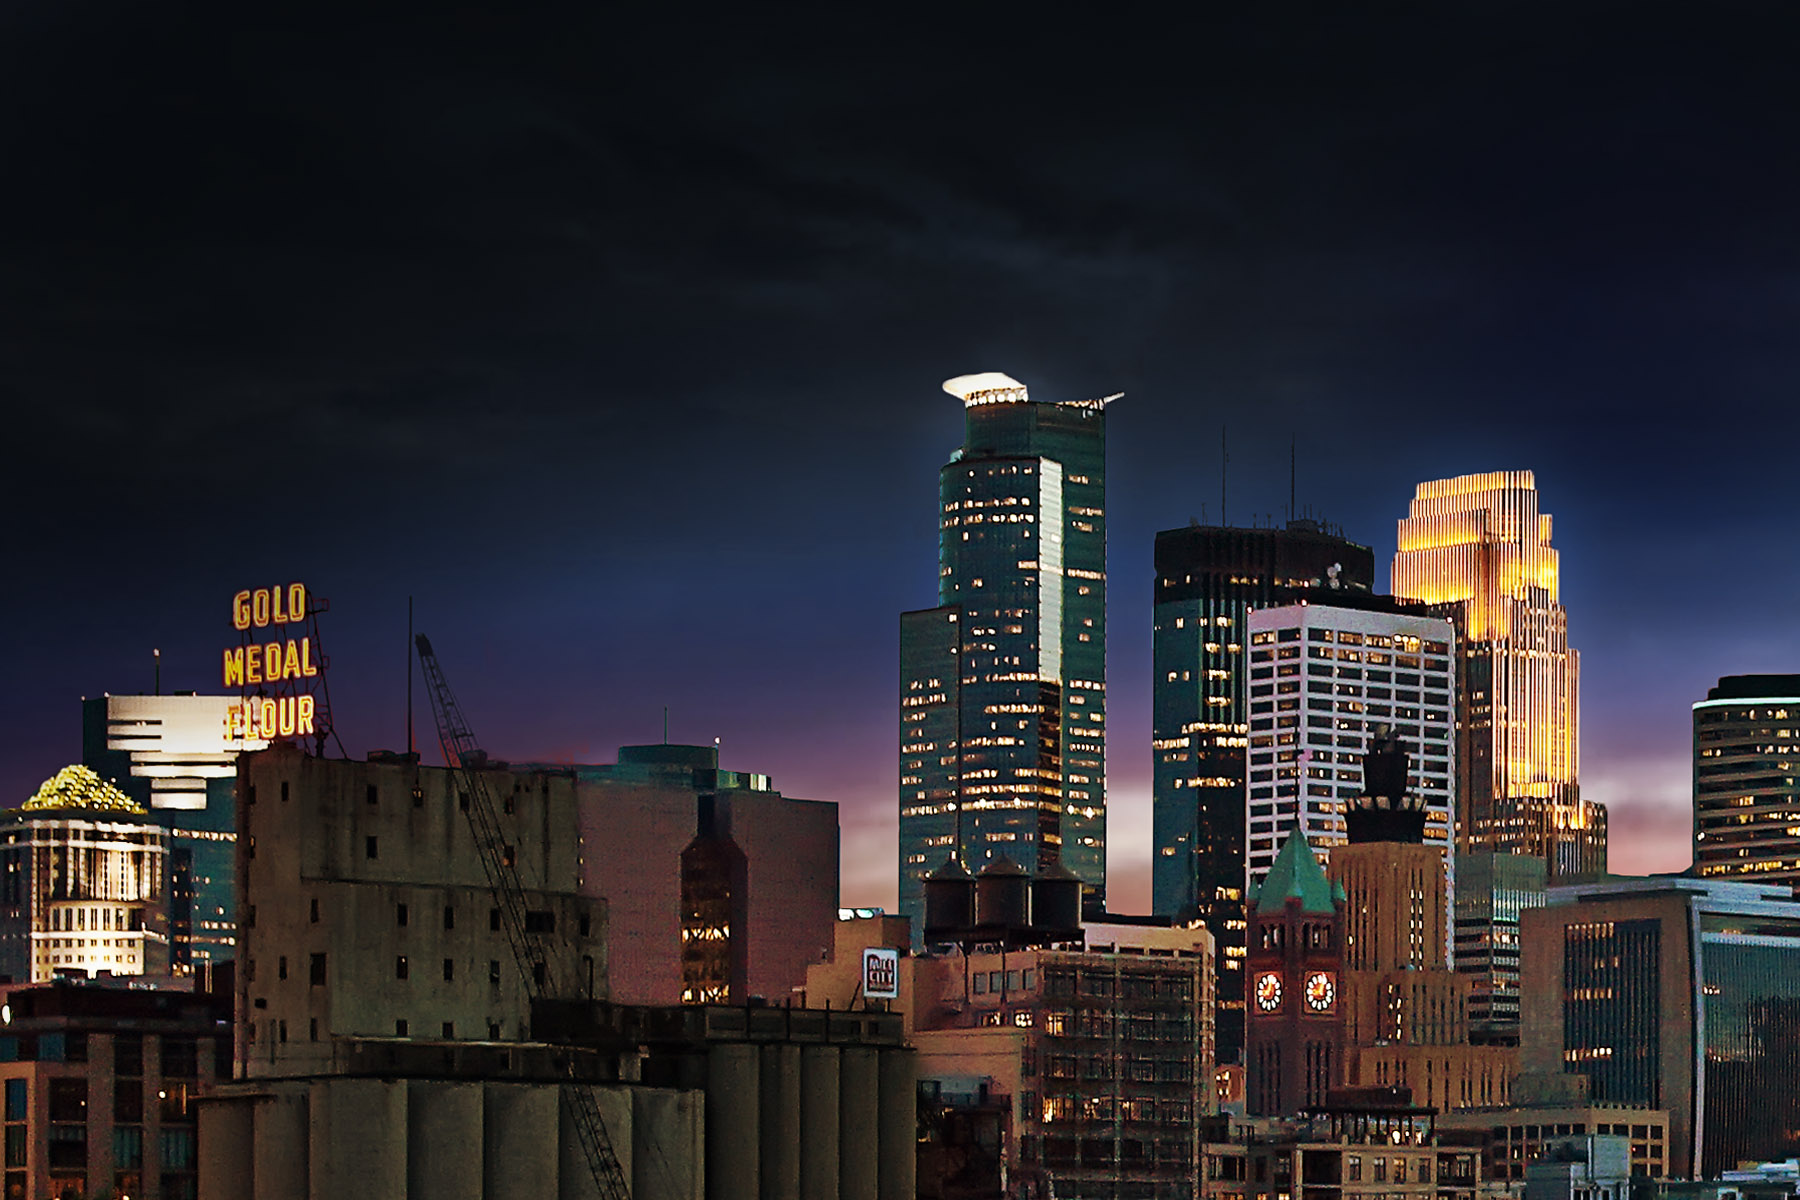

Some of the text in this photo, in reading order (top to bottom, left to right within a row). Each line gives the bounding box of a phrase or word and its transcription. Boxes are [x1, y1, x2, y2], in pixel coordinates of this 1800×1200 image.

[233, 583, 306, 630] GOLD
[224, 637, 317, 687] MEDAL
[226, 695, 314, 741] FLOUR
[869, 971, 894, 984] CITY
